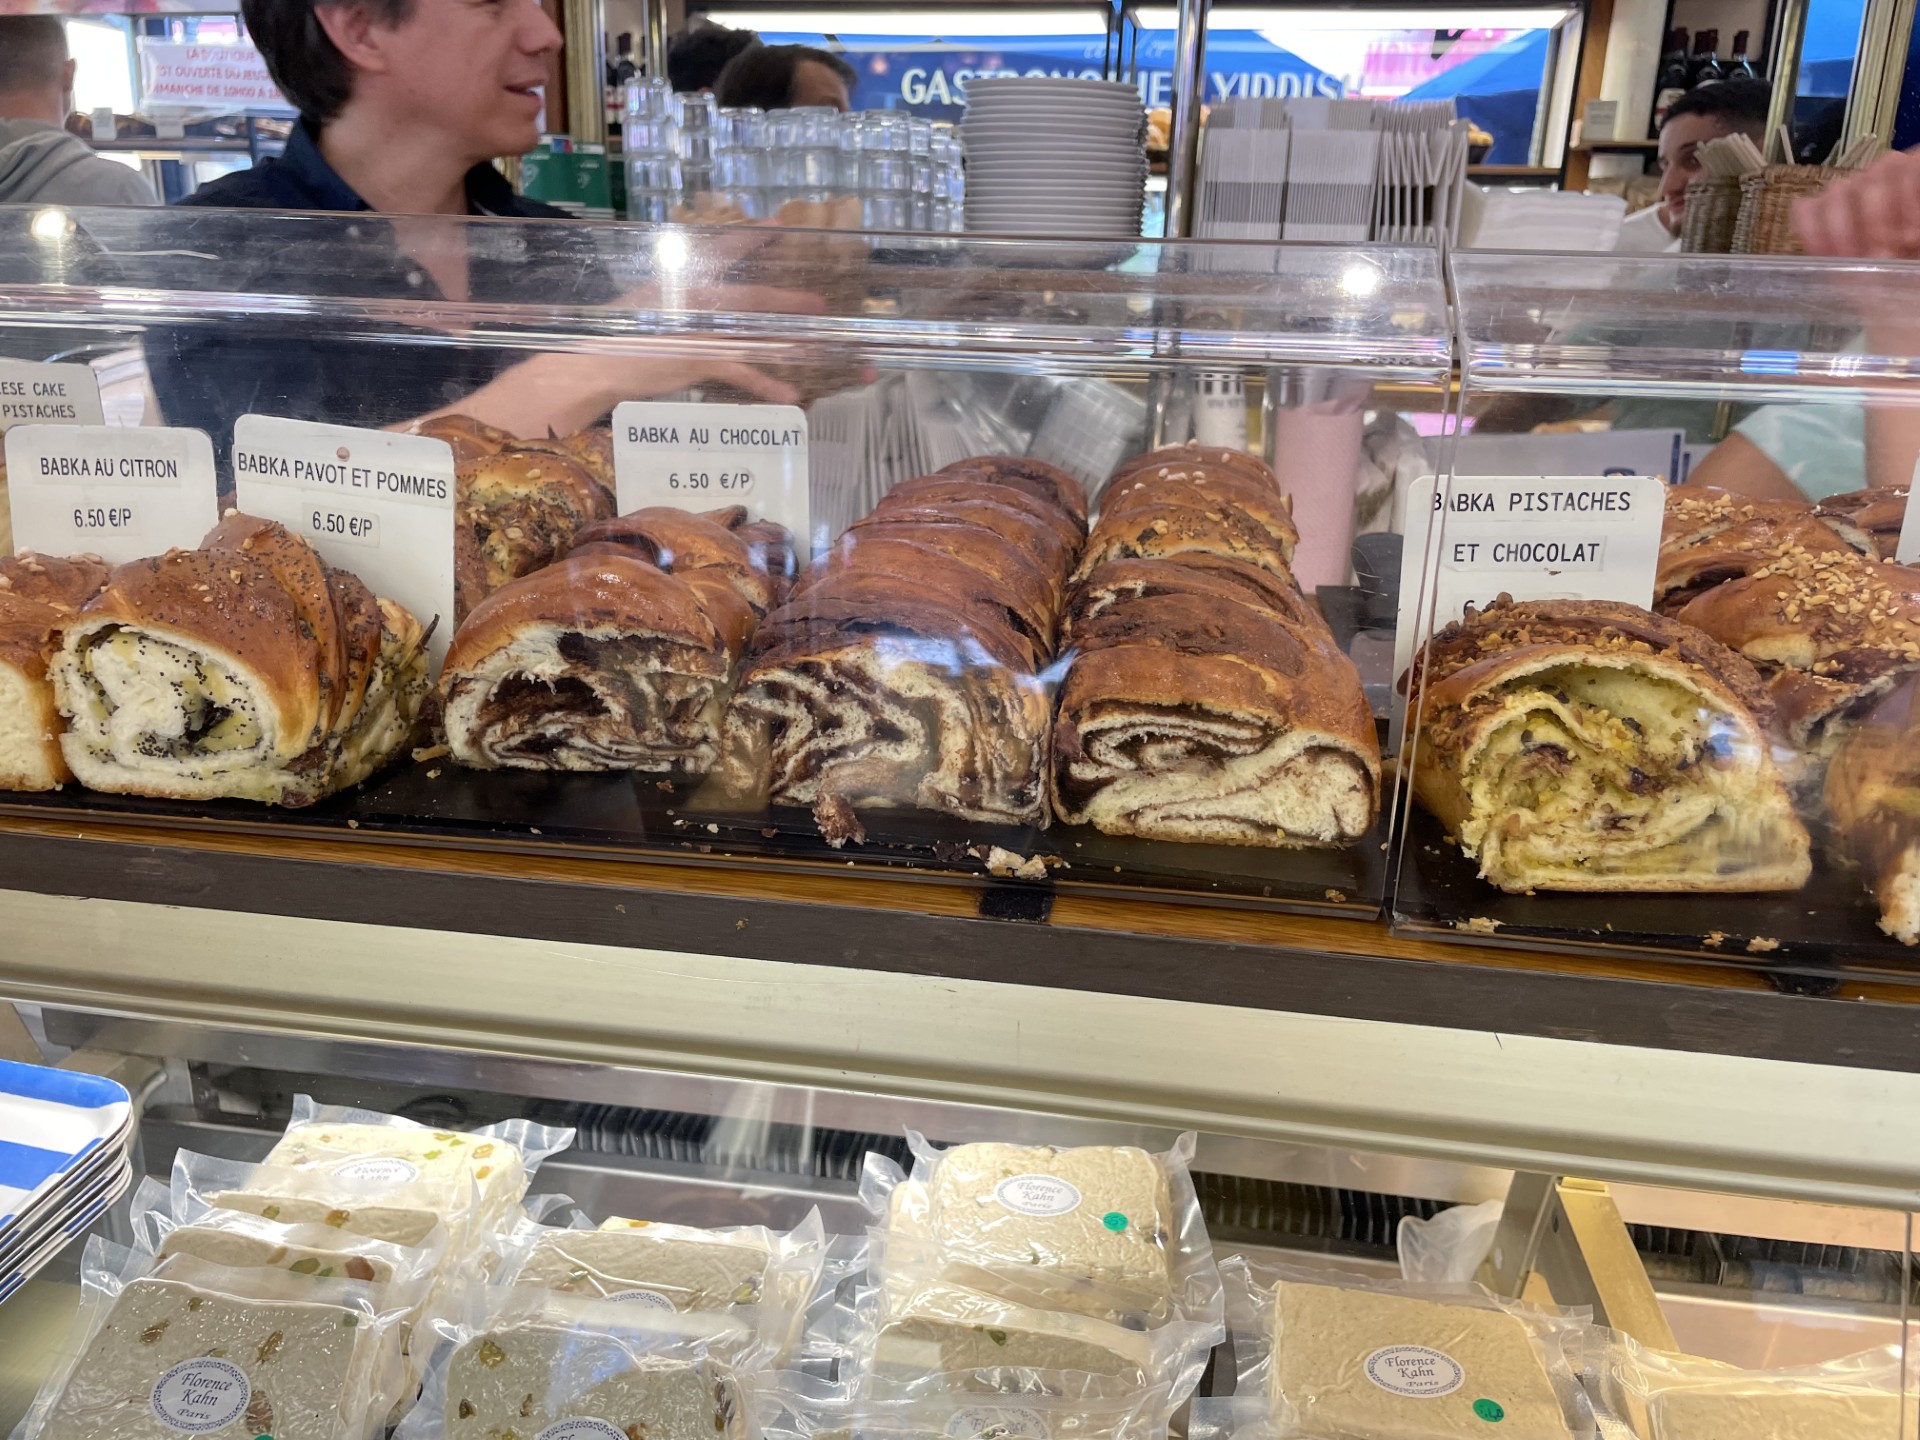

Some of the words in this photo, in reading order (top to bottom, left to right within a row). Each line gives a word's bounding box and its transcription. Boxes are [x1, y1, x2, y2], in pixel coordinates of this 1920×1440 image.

[154, 84, 204, 95] IMANCHE
[0, 382, 26, 396] ESE
[33, 383, 67, 397] CAKE
[2, 404, 76, 418] PISTACHES
[628, 426, 679, 444] BABKA
[689, 428, 709, 444] AU
[720, 428, 800, 446] CHOCOLAT
[41, 457, 90, 476] BABKA
[94, 459, 114, 476] AU
[120, 459, 177, 478] CITRON
[238, 452, 290, 477] BABKA
[295, 460, 346, 485] PAVOT
[352, 468, 371, 488] ET
[377, 471, 447, 499] POMMES
[669, 473, 709, 489] 6.50
[720, 473, 750, 489] €/P
[1431, 492, 1495, 512] BABKA
[1509, 491, 1631, 512] PISTACHES
[74, 509, 105, 528] 6.50
[312, 511, 345, 535] 6.50
[1453, 543, 1480, 562] ET
[1493, 543, 1600, 563] CHOCOLAT
[1017, 1182, 1063, 1194] Florence
[1022, 1191, 1055, 1202] Kahn
[1385, 1355, 1436, 1367] Florence
[1398, 1366, 1435, 1379] Kahn
[181, 1372, 233, 1391] Florence
[1406, 1380, 1439, 1388] Paris
[181, 1389, 218, 1406] Kahn
[177, 1408, 211, 1420] Paris
